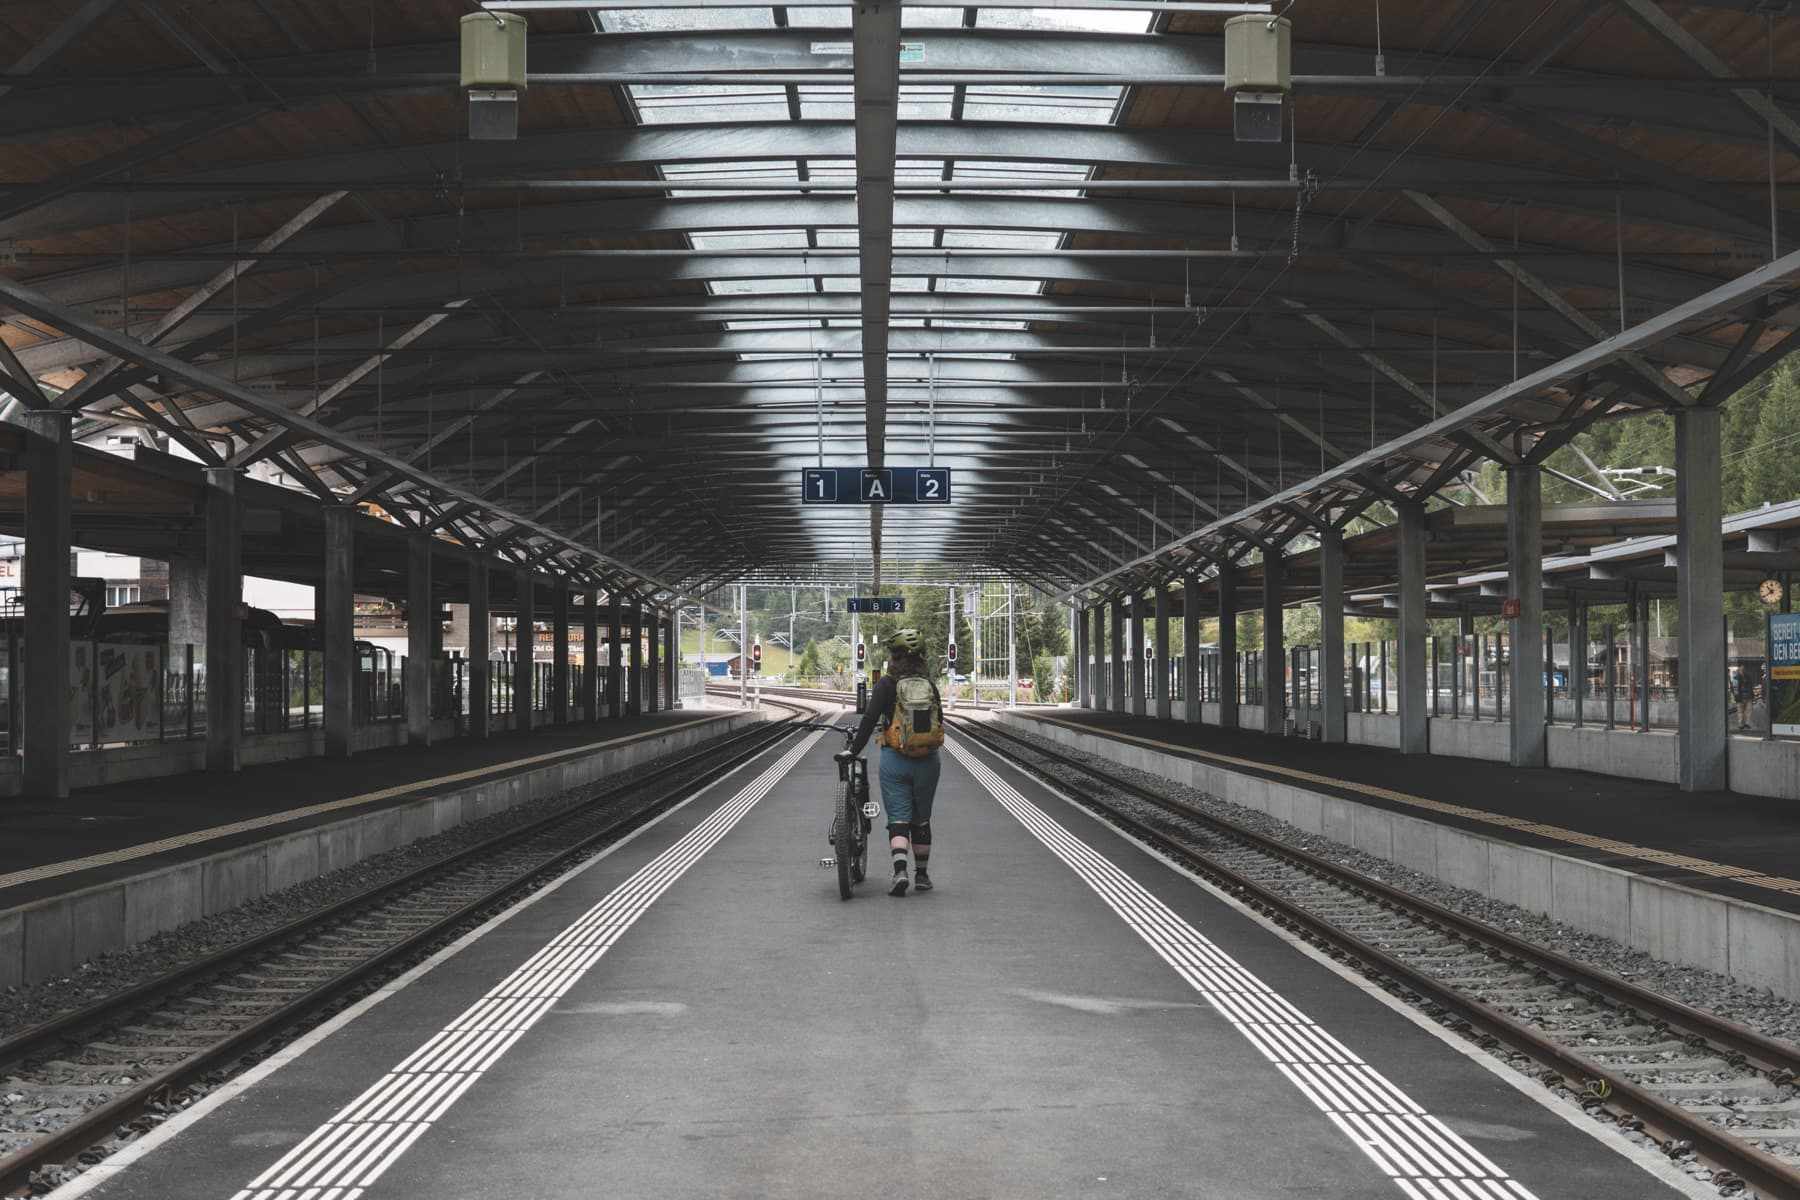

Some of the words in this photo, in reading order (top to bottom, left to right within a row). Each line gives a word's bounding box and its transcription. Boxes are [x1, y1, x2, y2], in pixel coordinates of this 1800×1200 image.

[816, 479, 824, 497] 1
[869, 479, 885, 497] A
[926, 479, 939, 497] 2
[894, 602, 901, 610] 2
[1773, 643, 1788, 661] DEN
